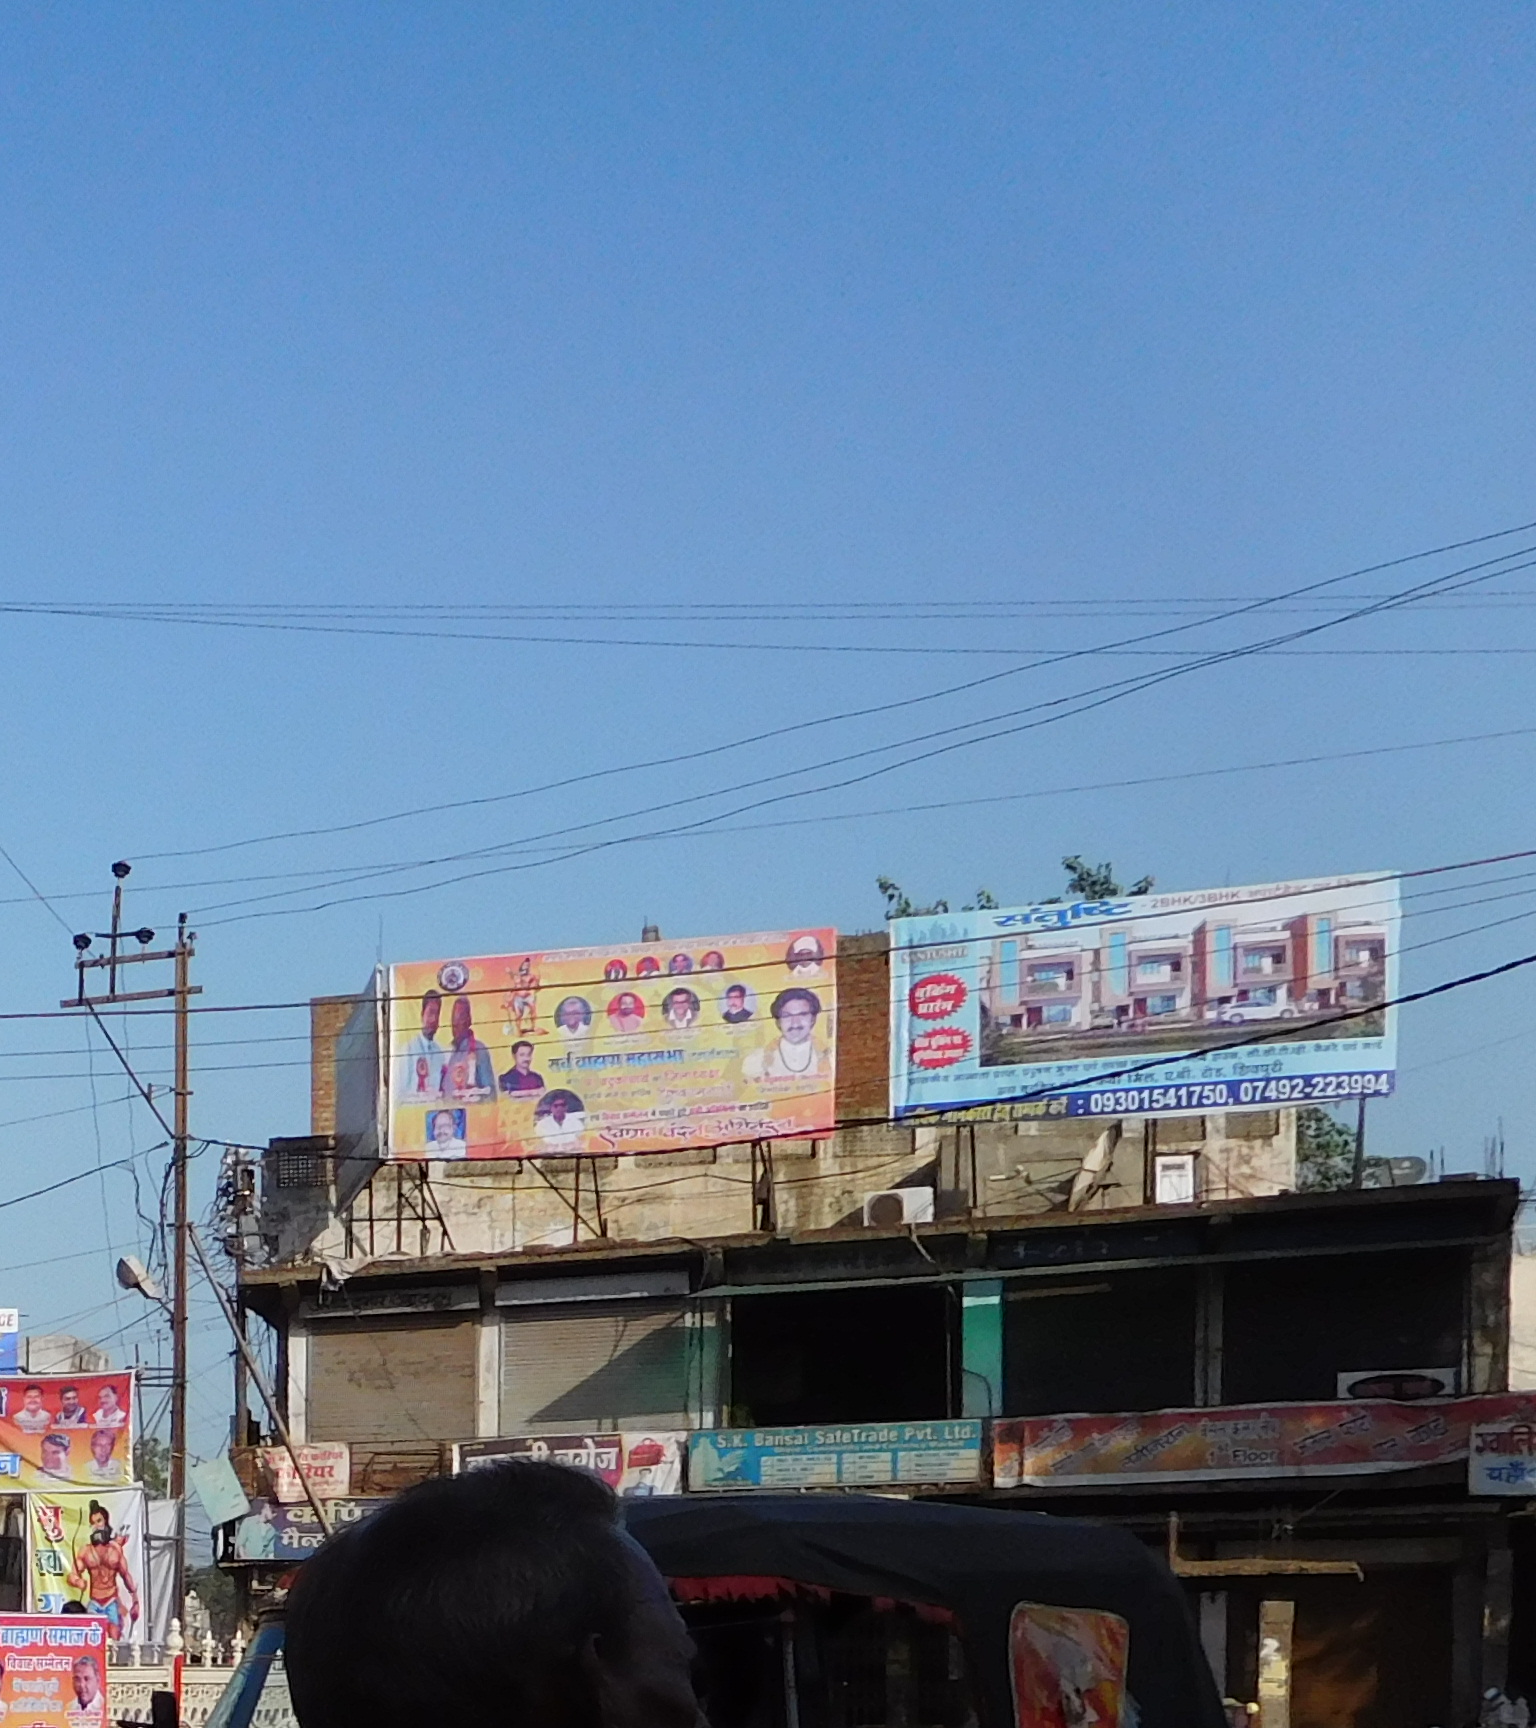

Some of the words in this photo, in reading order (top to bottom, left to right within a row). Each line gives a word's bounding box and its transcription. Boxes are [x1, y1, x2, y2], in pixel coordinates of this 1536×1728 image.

[1151, 890, 1241, 909] 2BHK/3BHK
[1232, 1059, 1284, 1079] शिवपुरी
[1090, 1082, 1234, 1114] 09301541750,
[1240, 1072, 1390, 1102] 07492-223994
[717, 1432, 748, 1448] S.K.
[754, 1431, 809, 1446] Bansal
[815, 1428, 898, 1444] SafeTrade
[904, 1427, 937, 1441] Pvt.
[944, 1425, 977, 1439] Ltd.
[1232, 1448, 1276, 1463] Floor
[0, 1625, 44, 1648] ब्राह्मण
[46, 1625, 87, 1646] समाज
[88, 1622, 103, 1646] के
